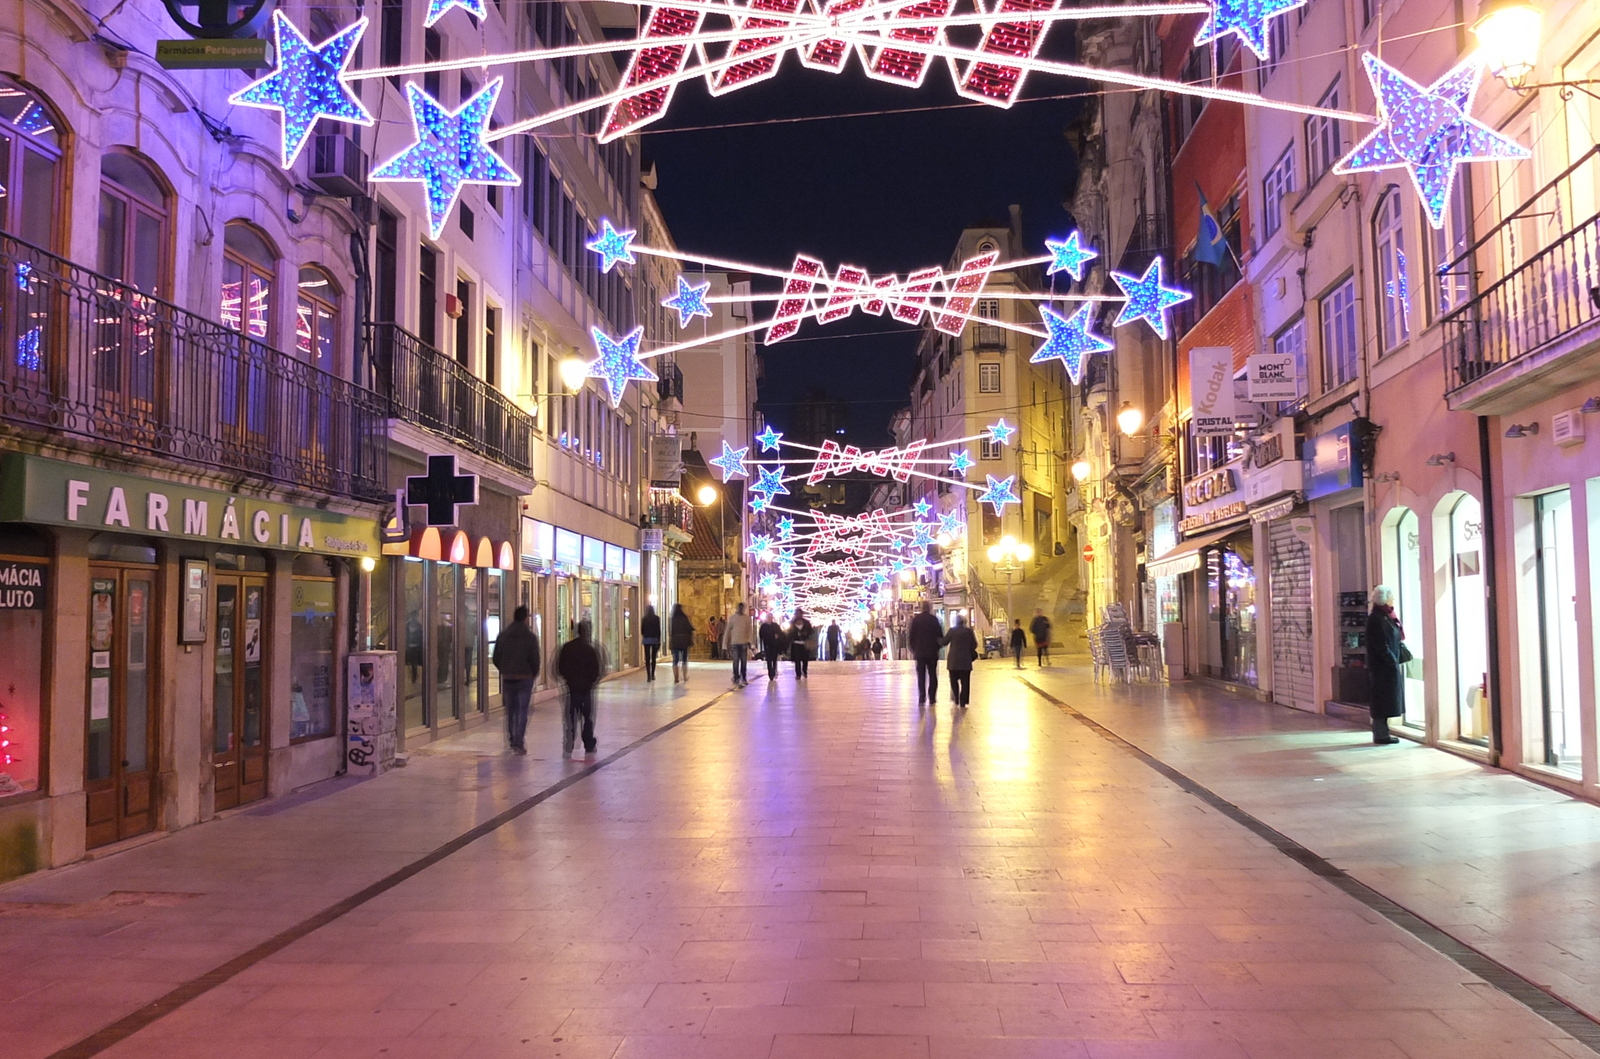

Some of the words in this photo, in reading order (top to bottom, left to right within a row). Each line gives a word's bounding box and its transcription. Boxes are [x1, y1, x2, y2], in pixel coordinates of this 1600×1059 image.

[1259, 371, 1285, 379] BLANC
[1197, 360, 1227, 415] Kodak
[1197, 417, 1232, 426] CRISTAL
[1197, 426, 1232, 434] Papelaria
[66, 479, 315, 548] FARMÁCIA
